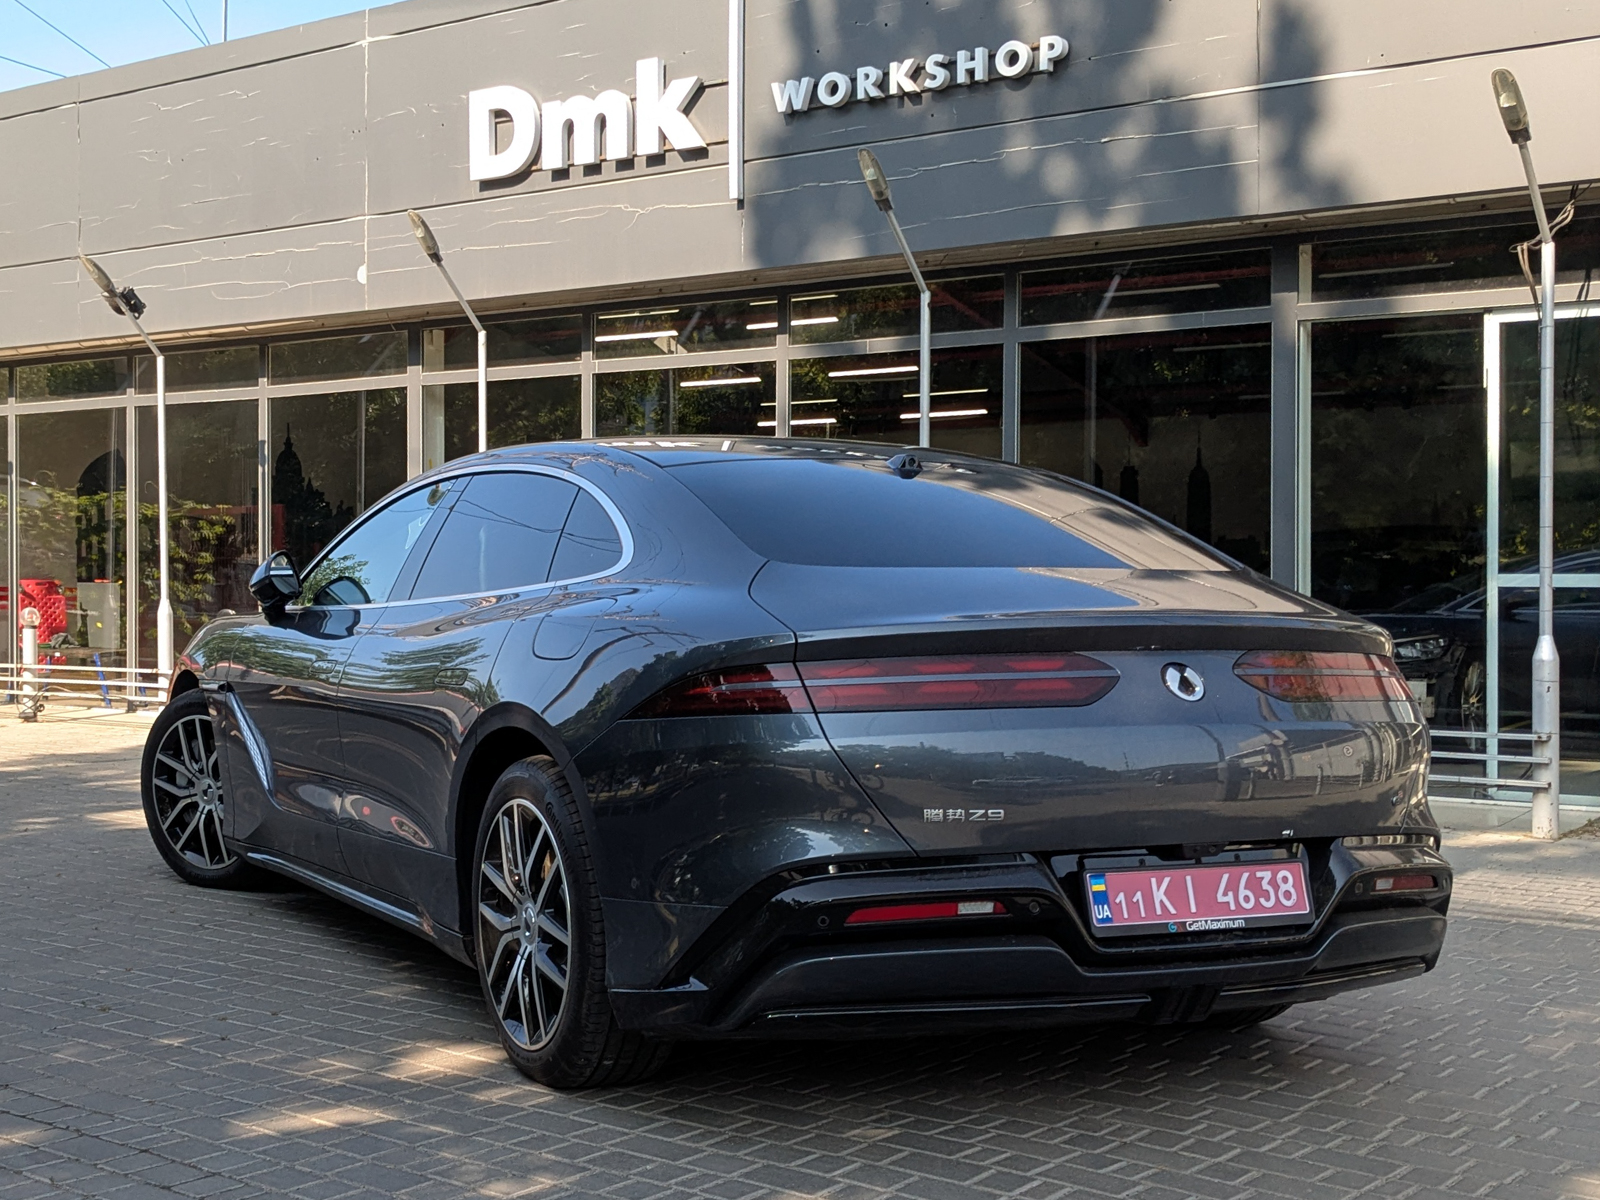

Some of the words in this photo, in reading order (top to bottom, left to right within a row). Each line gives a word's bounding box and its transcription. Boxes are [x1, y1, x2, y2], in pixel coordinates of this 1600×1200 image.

[771, 35, 1069, 113] WORKSHOP
[469, 57, 707, 181] Dmk
[1216, 869, 1297, 911] 4638
[1094, 904, 1112, 919] UA
[1186, 919, 1246, 931] GetMaximum
